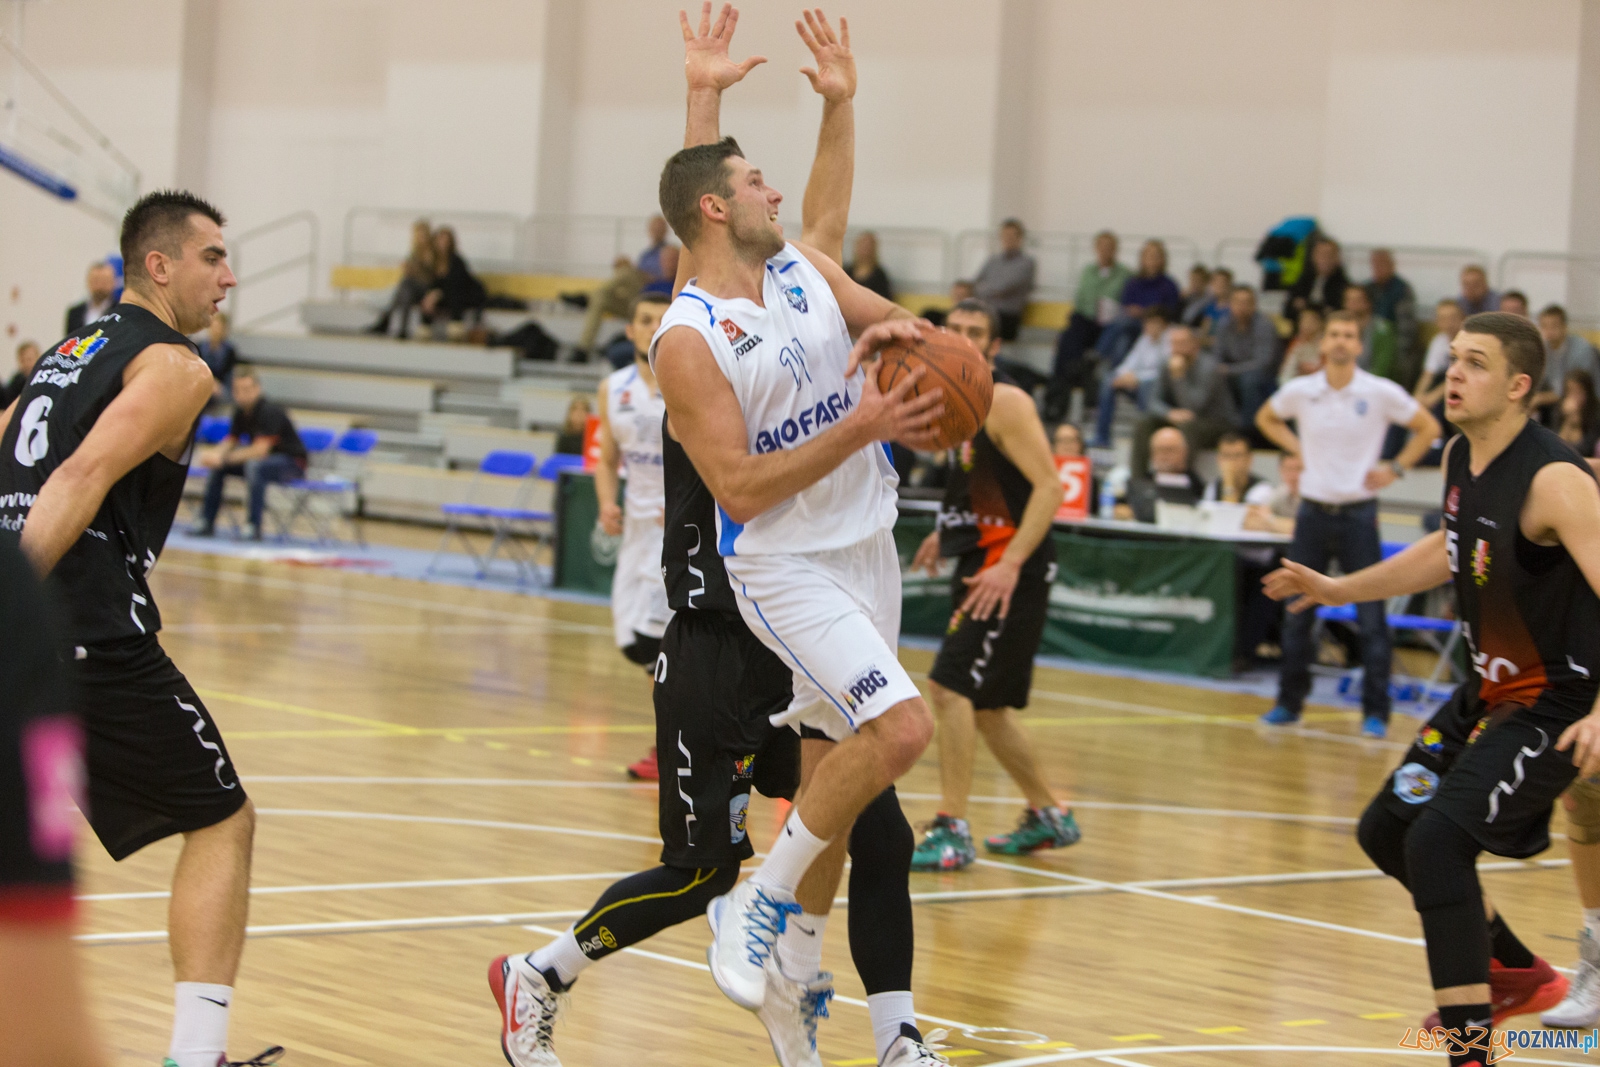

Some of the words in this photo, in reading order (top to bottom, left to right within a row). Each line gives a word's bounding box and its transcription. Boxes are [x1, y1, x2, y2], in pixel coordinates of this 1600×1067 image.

[14, 395, 53, 467] 6
[1059, 461, 1086, 502] 5
[849, 670, 888, 705] PBG
